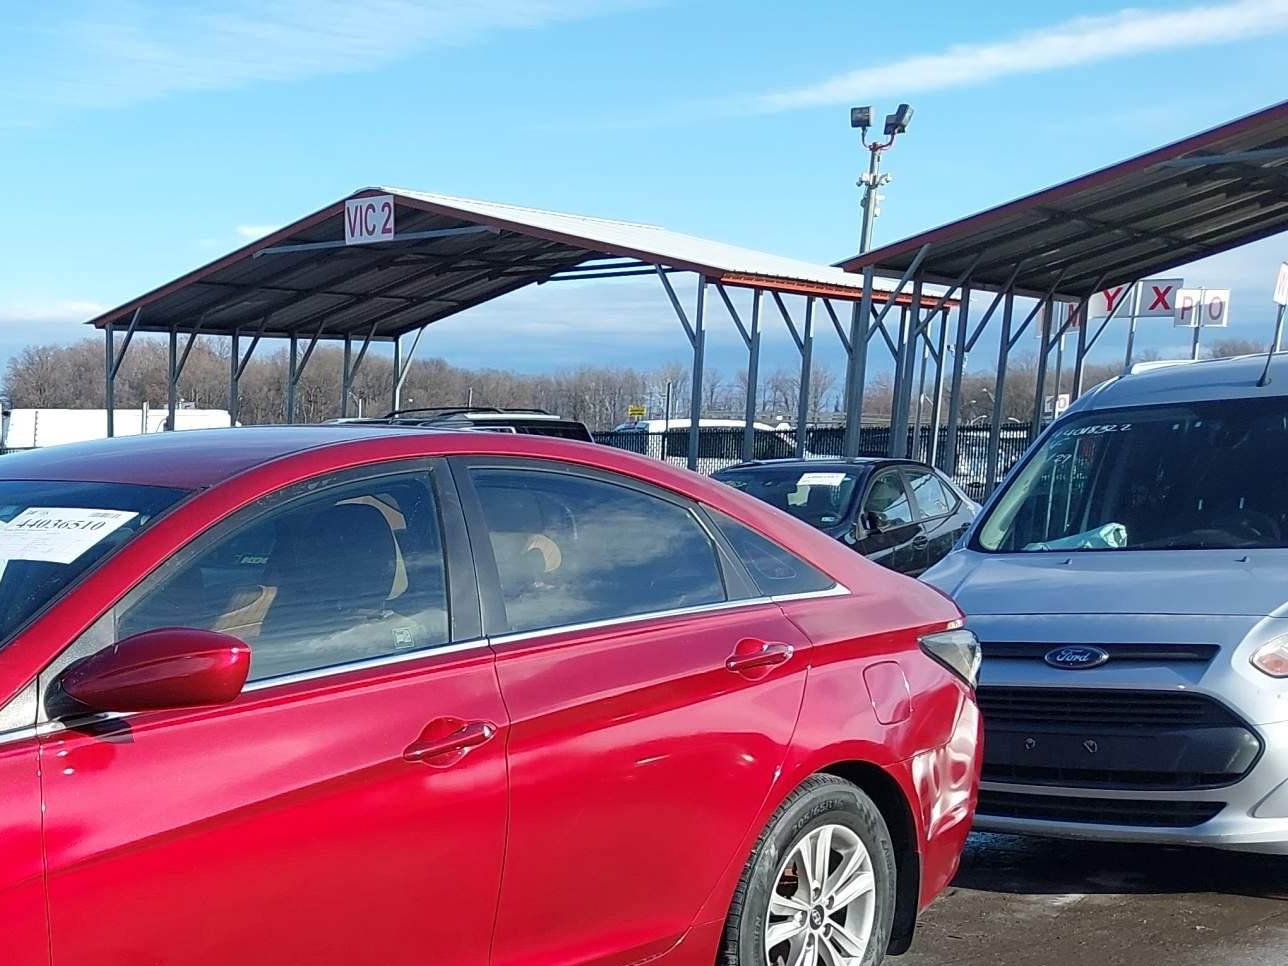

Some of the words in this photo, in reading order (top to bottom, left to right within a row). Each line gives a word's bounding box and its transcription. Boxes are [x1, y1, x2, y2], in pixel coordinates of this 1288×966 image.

[346, 202, 377, 238] VIC
[381, 201, 393, 235] 2
[1103, 287, 1123, 312] Y
[1148, 285, 1173, 311] X
[1180, 295, 1194, 321] P
[16, 517, 107, 531] 44036510
[1056, 649, 1091, 662] Ford
